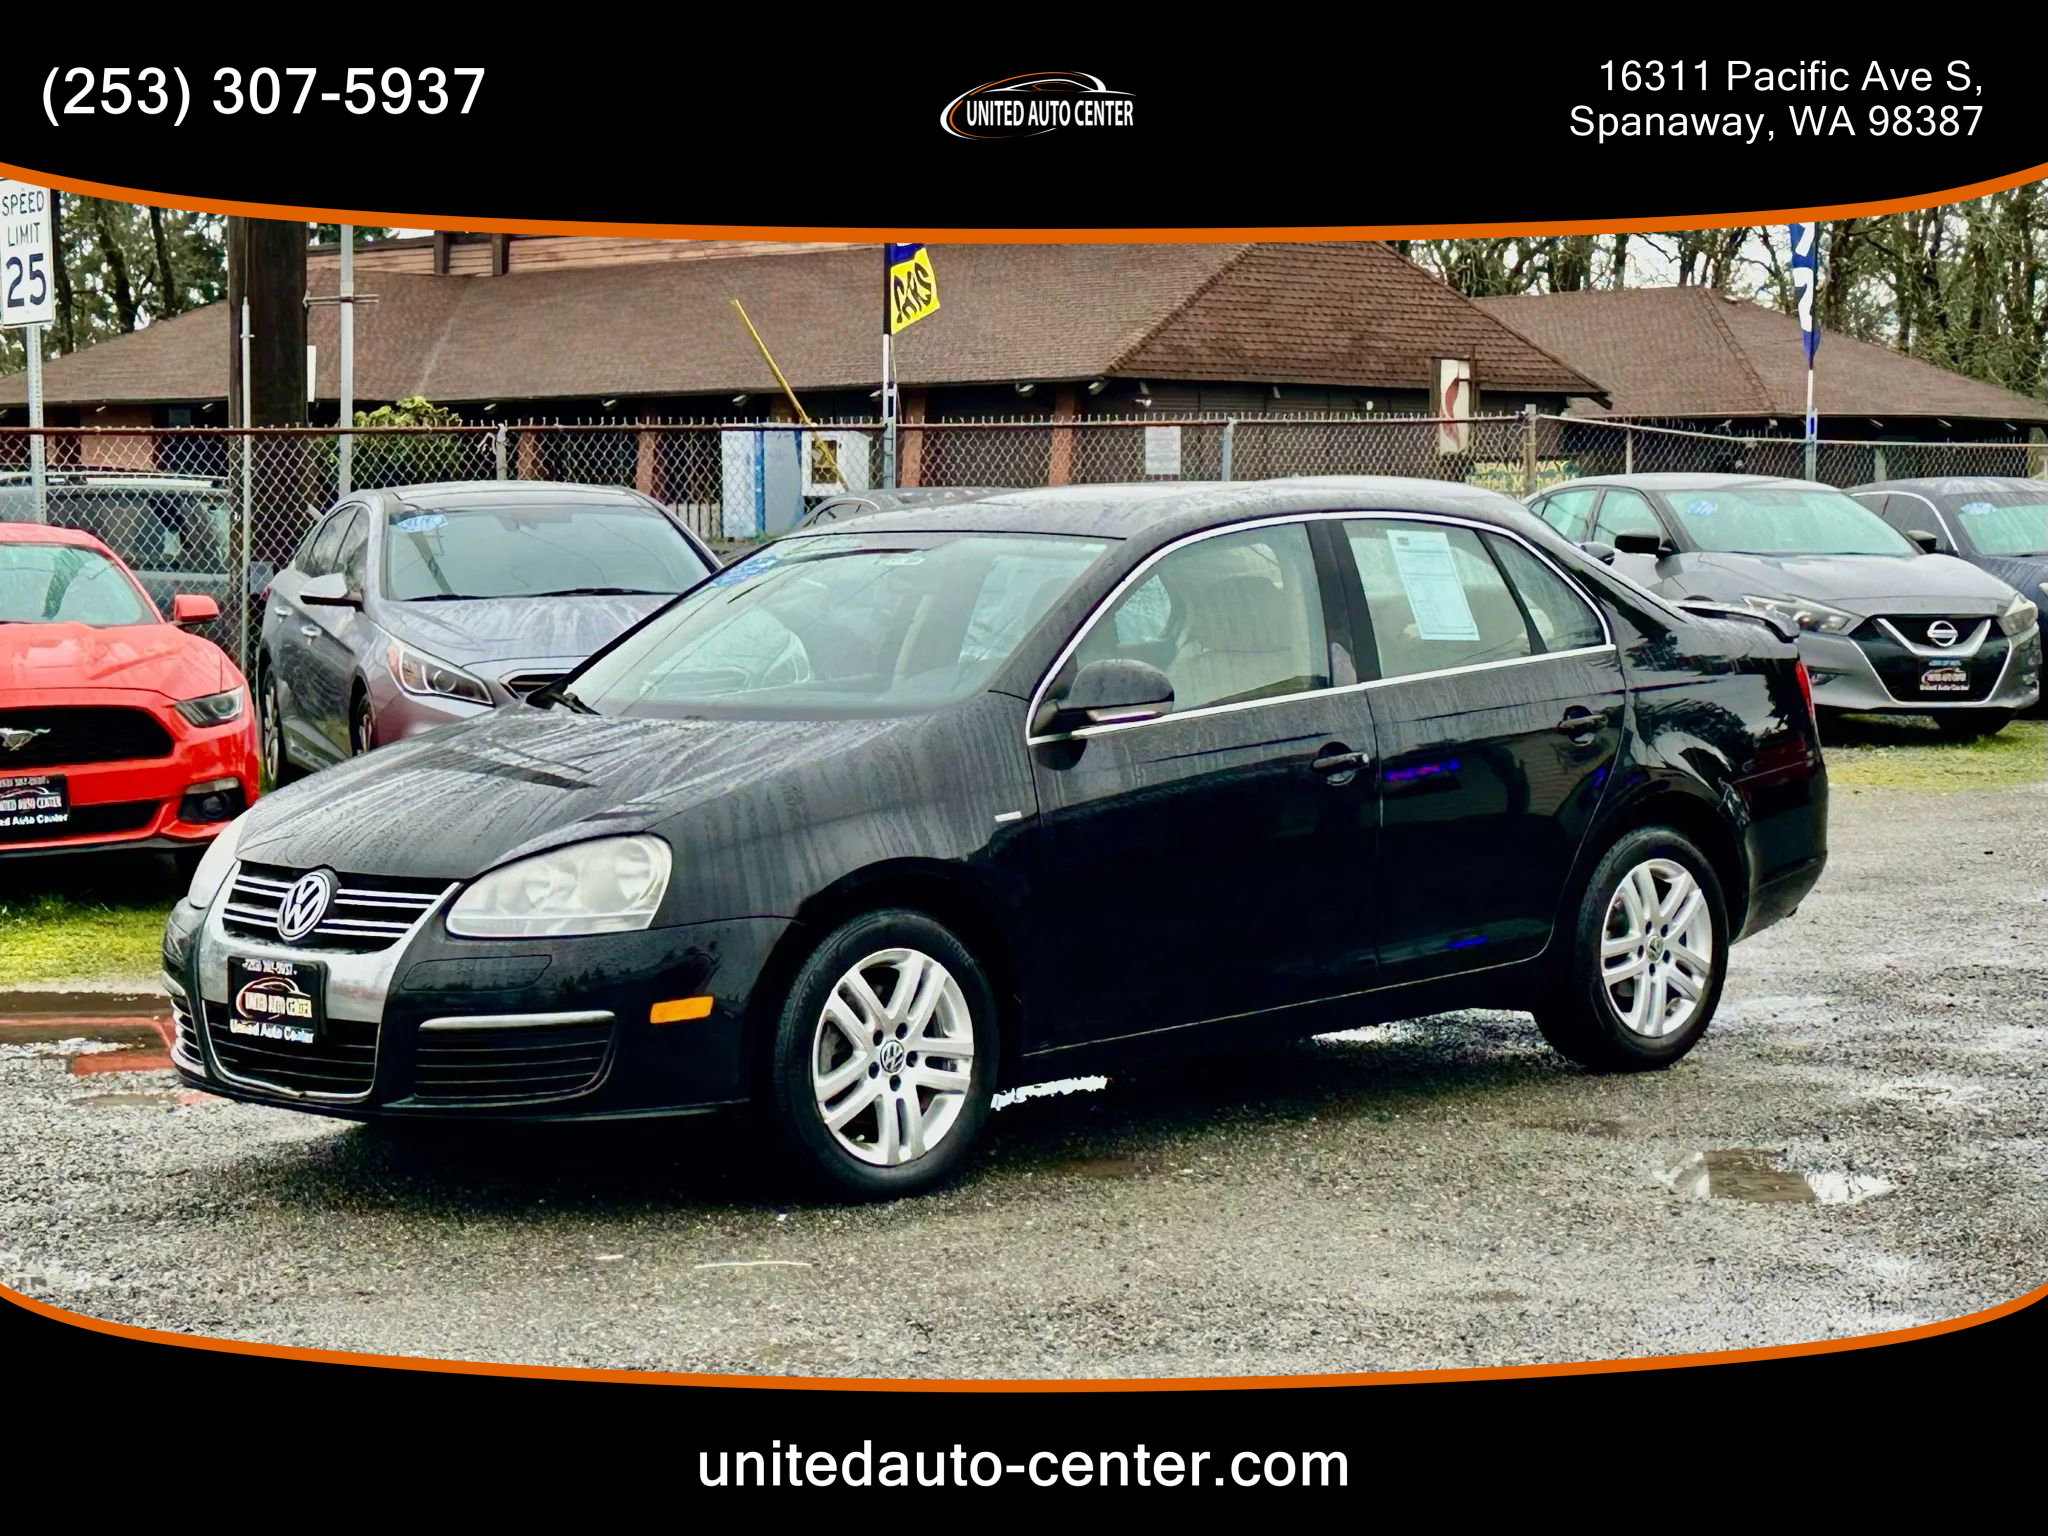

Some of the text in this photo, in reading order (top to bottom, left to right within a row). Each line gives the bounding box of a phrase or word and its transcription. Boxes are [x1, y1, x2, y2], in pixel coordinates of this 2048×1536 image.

[2, 191, 44, 216] SPEED
[8, 222, 40, 247] LIMIT
[6, 253, 47, 308] 25
